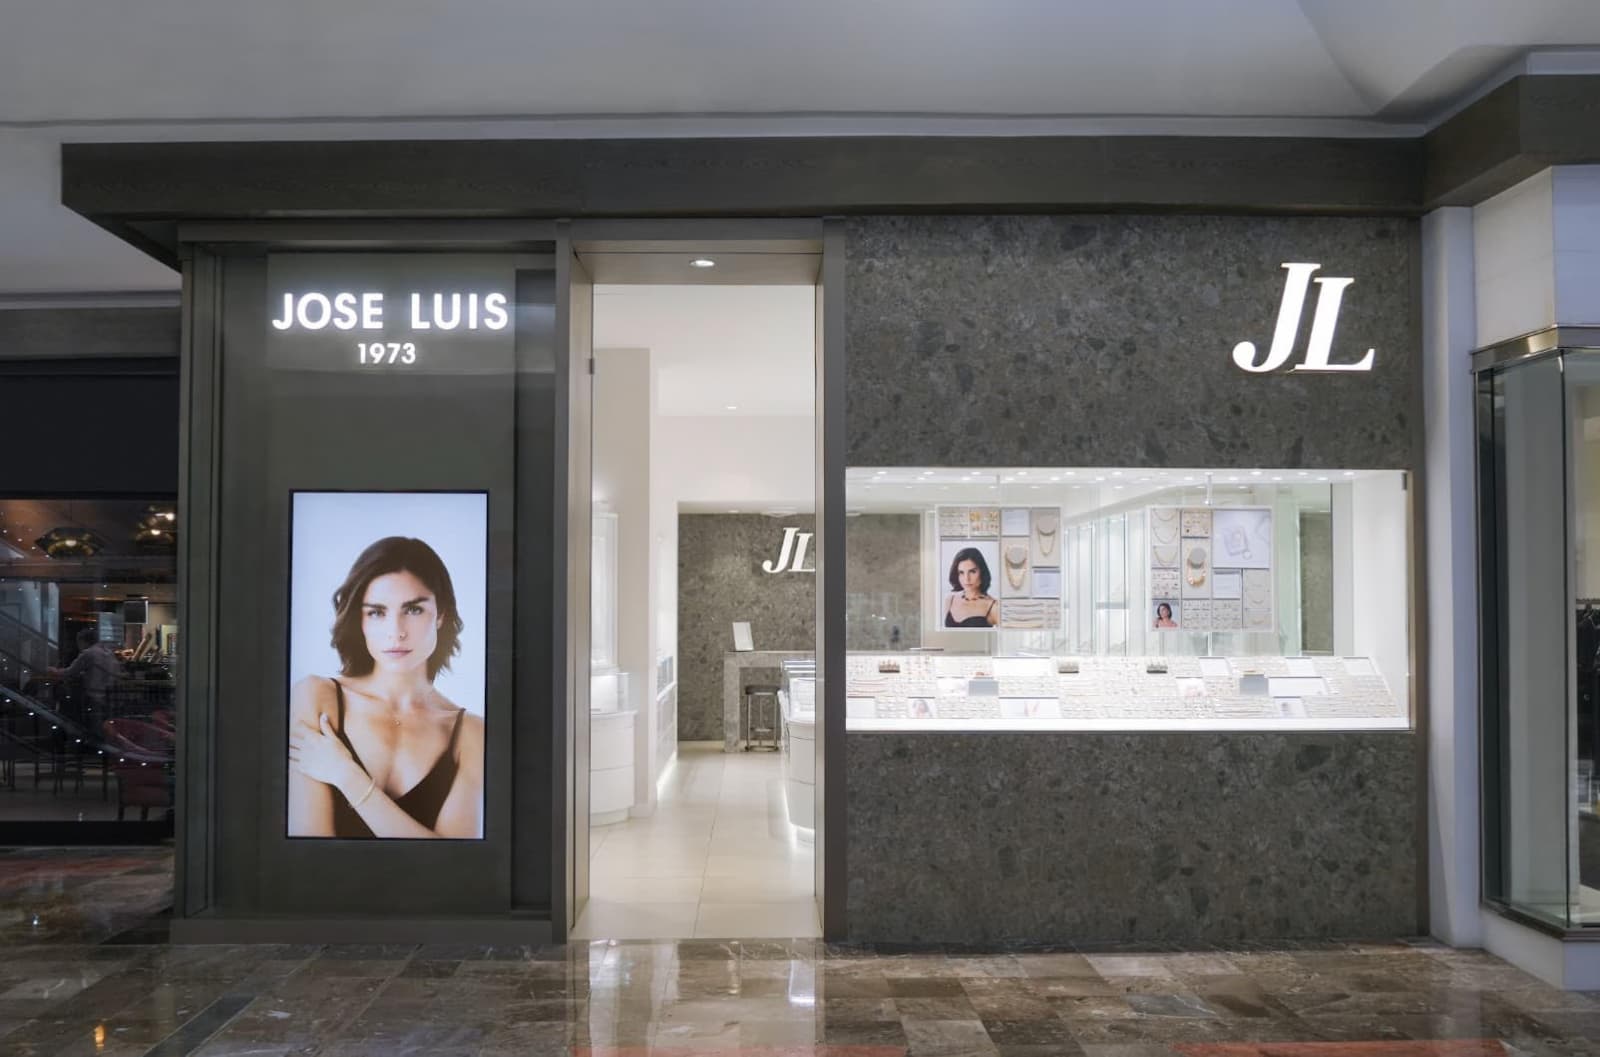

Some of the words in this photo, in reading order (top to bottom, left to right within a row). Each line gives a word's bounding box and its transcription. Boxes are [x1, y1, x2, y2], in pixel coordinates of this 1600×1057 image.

[272, 292, 384, 330] JOSE
[411, 292, 508, 330] LUIS
[1232, 262, 1376, 373] JL
[358, 342, 416, 365] 1973
[762, 527, 816, 574] JL
